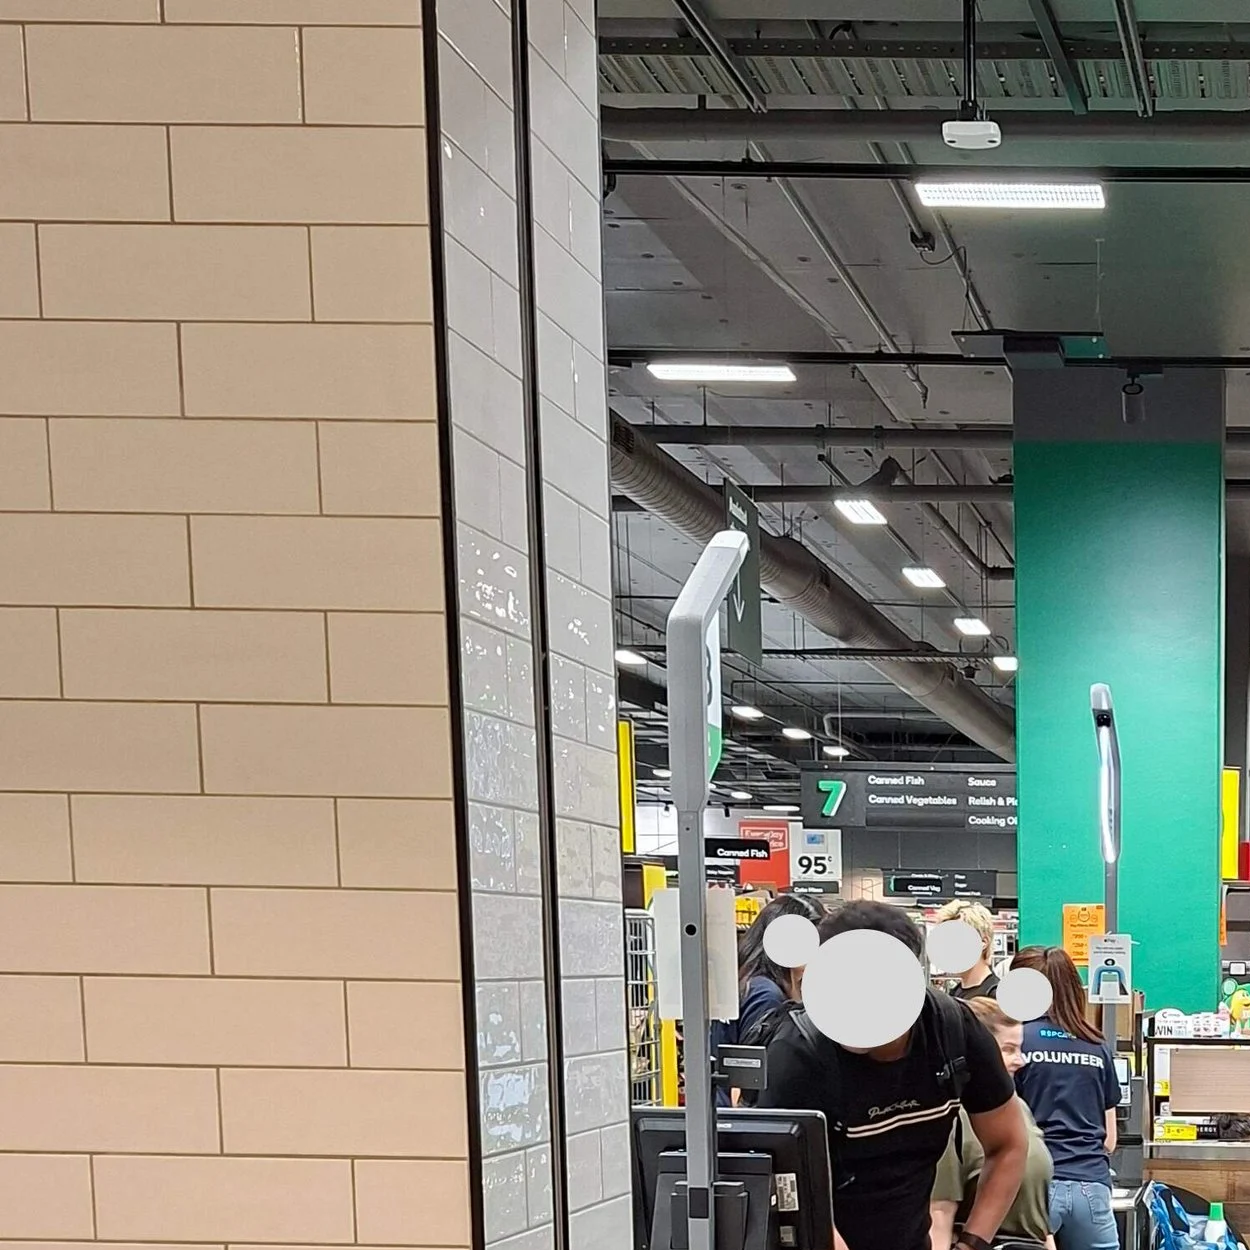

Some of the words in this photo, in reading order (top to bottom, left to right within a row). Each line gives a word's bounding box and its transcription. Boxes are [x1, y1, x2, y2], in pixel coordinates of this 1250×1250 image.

[868, 775, 902, 786] Canned
[905, 776, 925, 786] Fish
[968, 777, 996, 786] Sauce
[817, 780, 847, 817] 7
[868, 795, 903, 804] Canned
[905, 795, 957, 806] Vegetables
[968, 796, 996, 806] Relish
[997, 797, 1005, 806] &
[969, 816, 1005, 827] Cooking
[717, 848, 749, 857] Canned
[751, 849, 768, 858] Fish
[1022, 1050, 1104, 1069] VOLUNTEER
